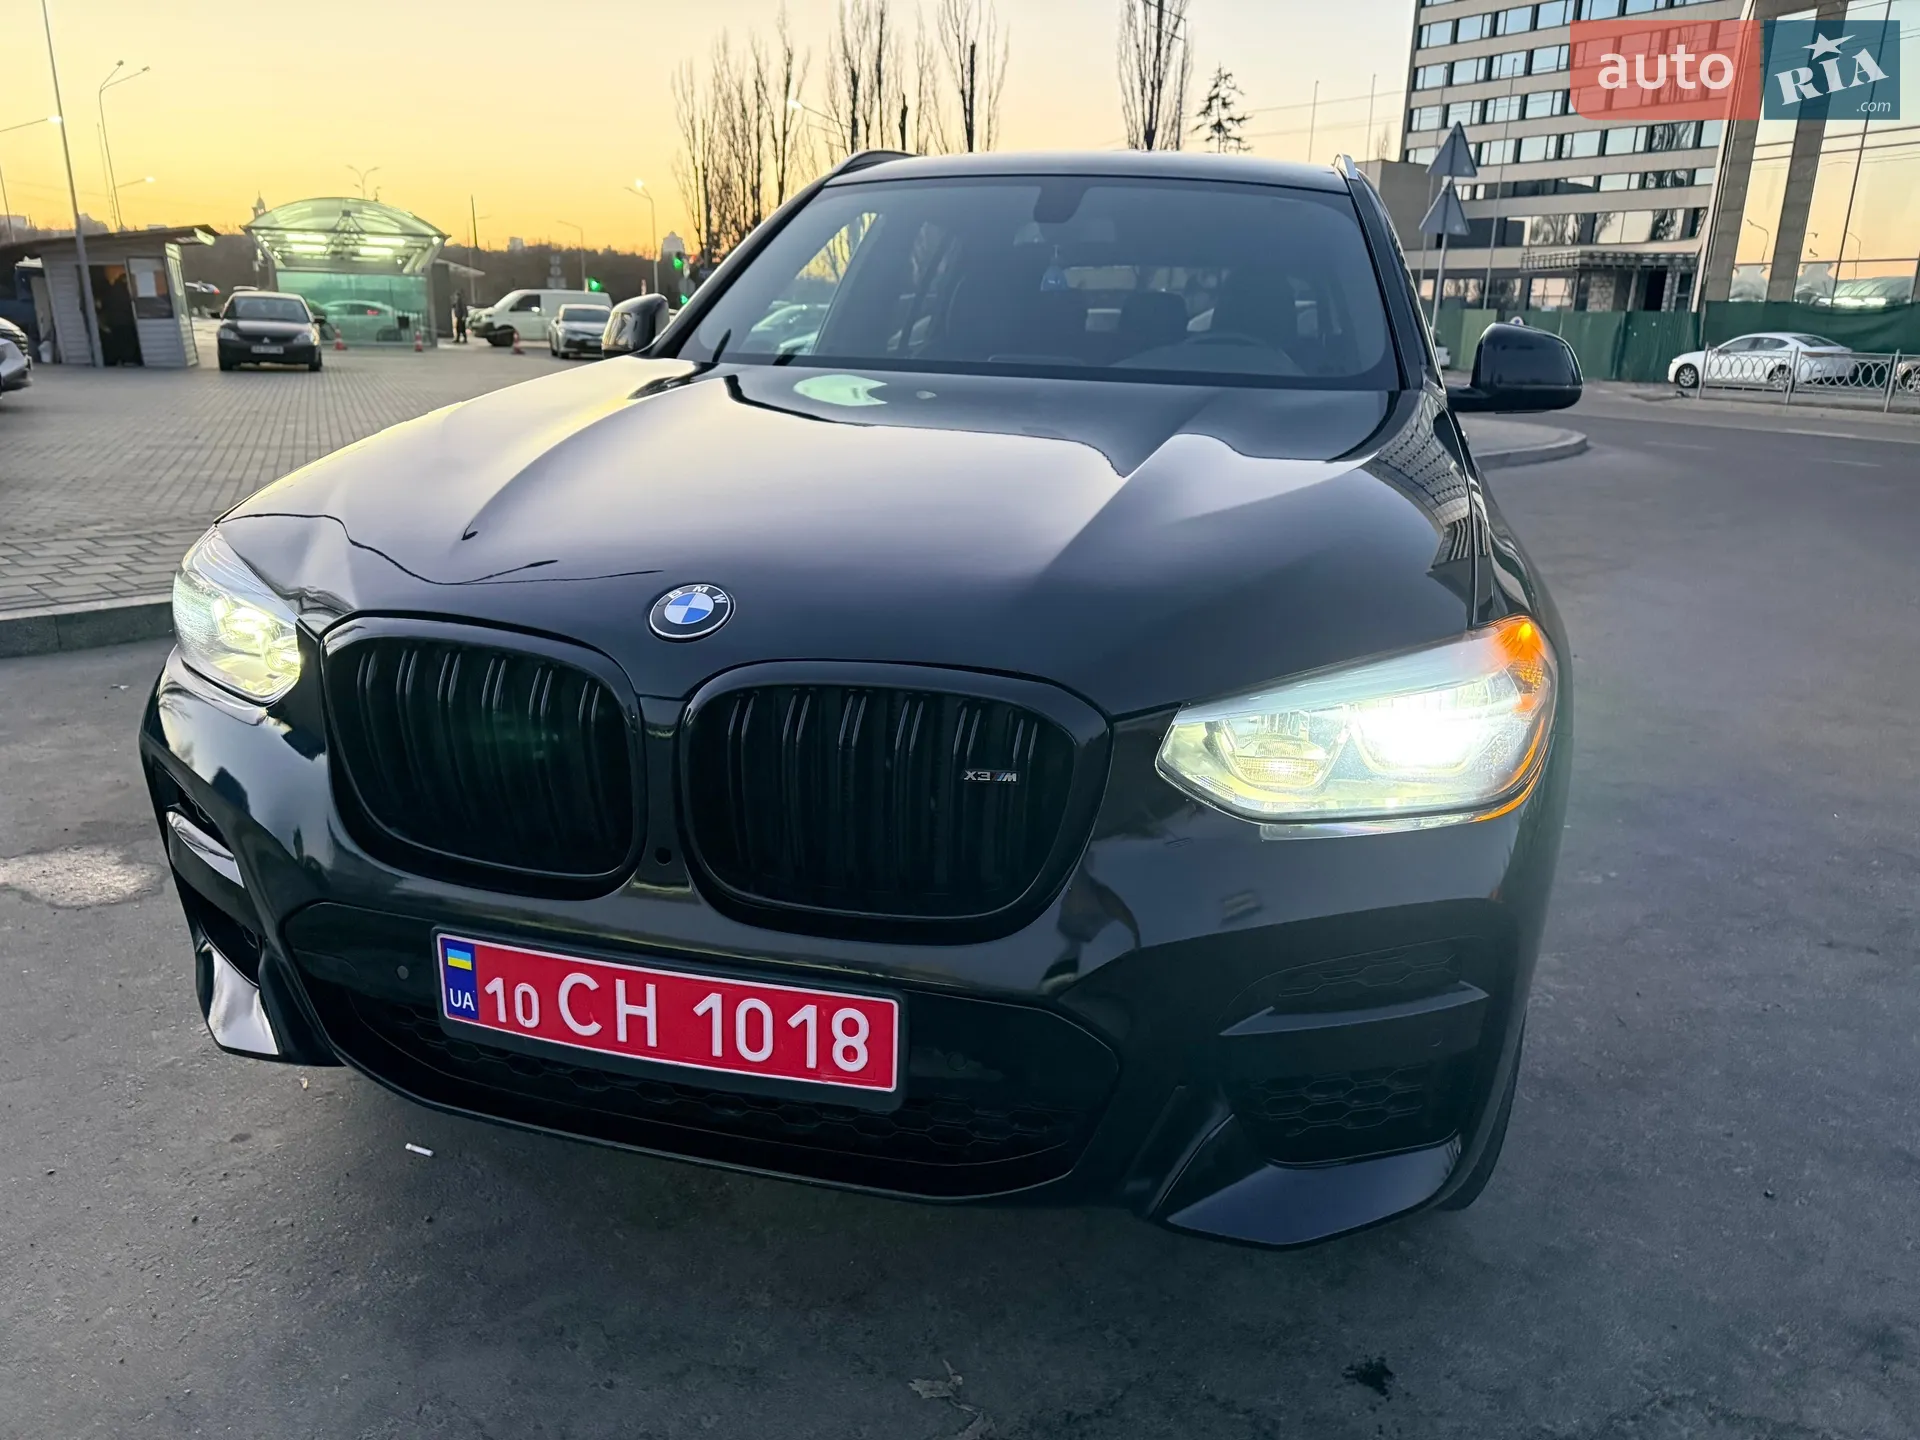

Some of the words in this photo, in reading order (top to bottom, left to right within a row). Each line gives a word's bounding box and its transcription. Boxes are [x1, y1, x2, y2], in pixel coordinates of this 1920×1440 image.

[667, 586, 728, 604] BMW
[963, 770, 991, 781] X3
[449, 988, 476, 1012] UA
[484, 976, 540, 1029] 10
[557, 972, 658, 1048] CH
[692, 993, 870, 1073] 1018
